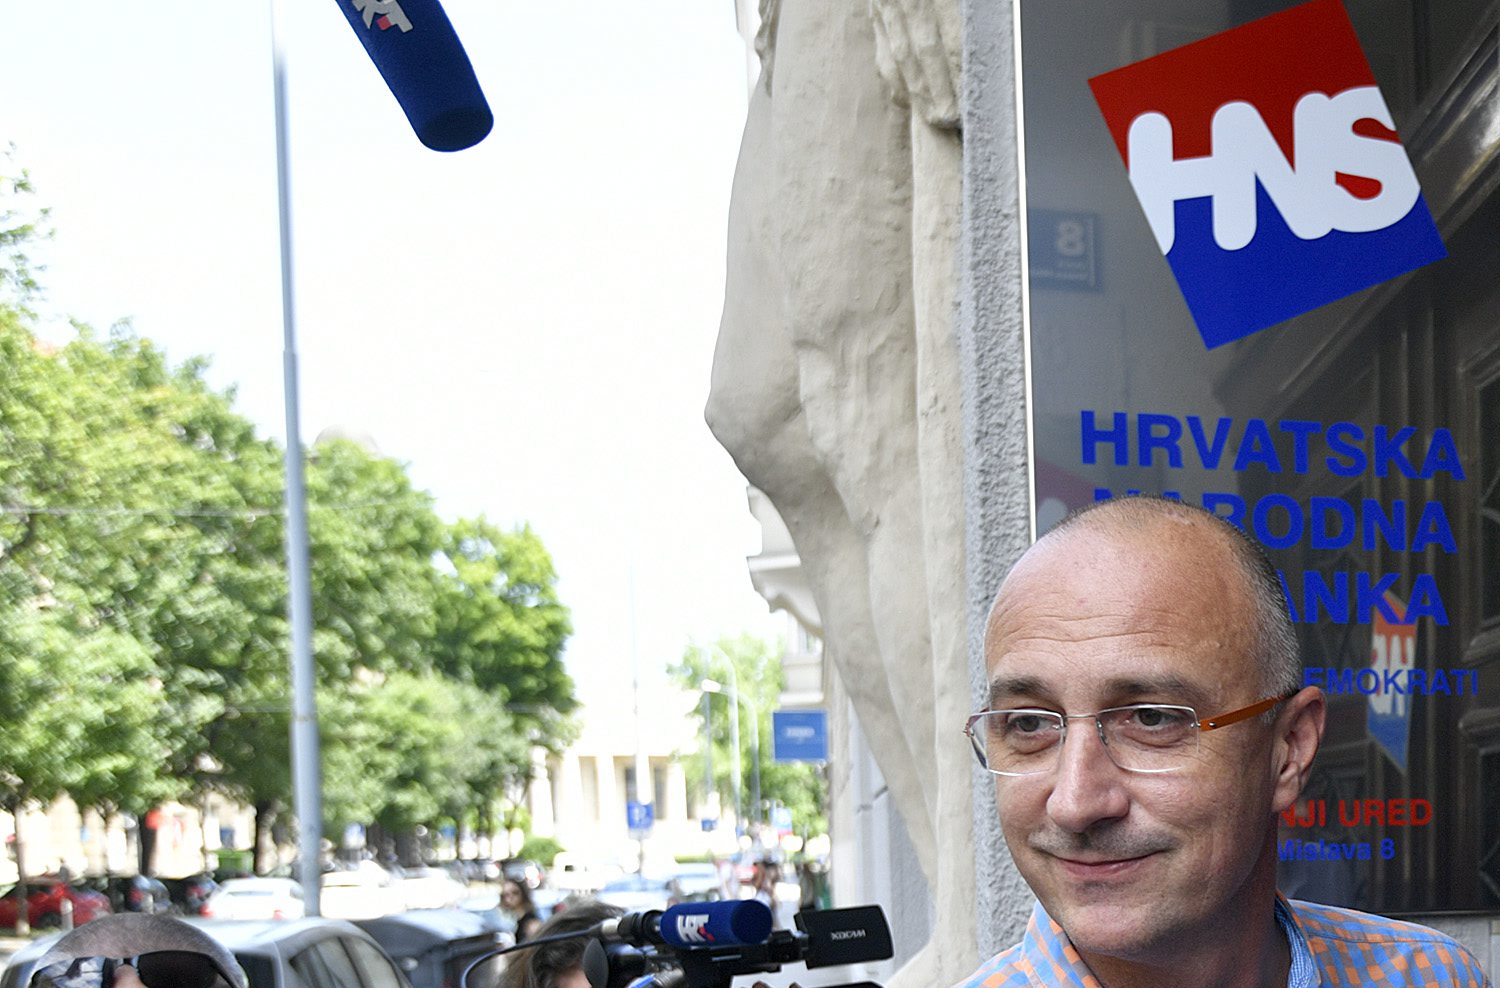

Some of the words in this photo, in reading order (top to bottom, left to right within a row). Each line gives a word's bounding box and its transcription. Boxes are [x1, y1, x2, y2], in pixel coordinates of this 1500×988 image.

[1127, 86, 1421, 256] HNS
[1080, 410, 1466, 481] HRVATSKA
[1094, 488, 1458, 553] RODNA
[1302, 667, 1479, 696] EMOKRATI
[1281, 799, 1326, 828] NJI
[1338, 799, 1433, 827] URED
[1380, 838, 1395, 861] 8
